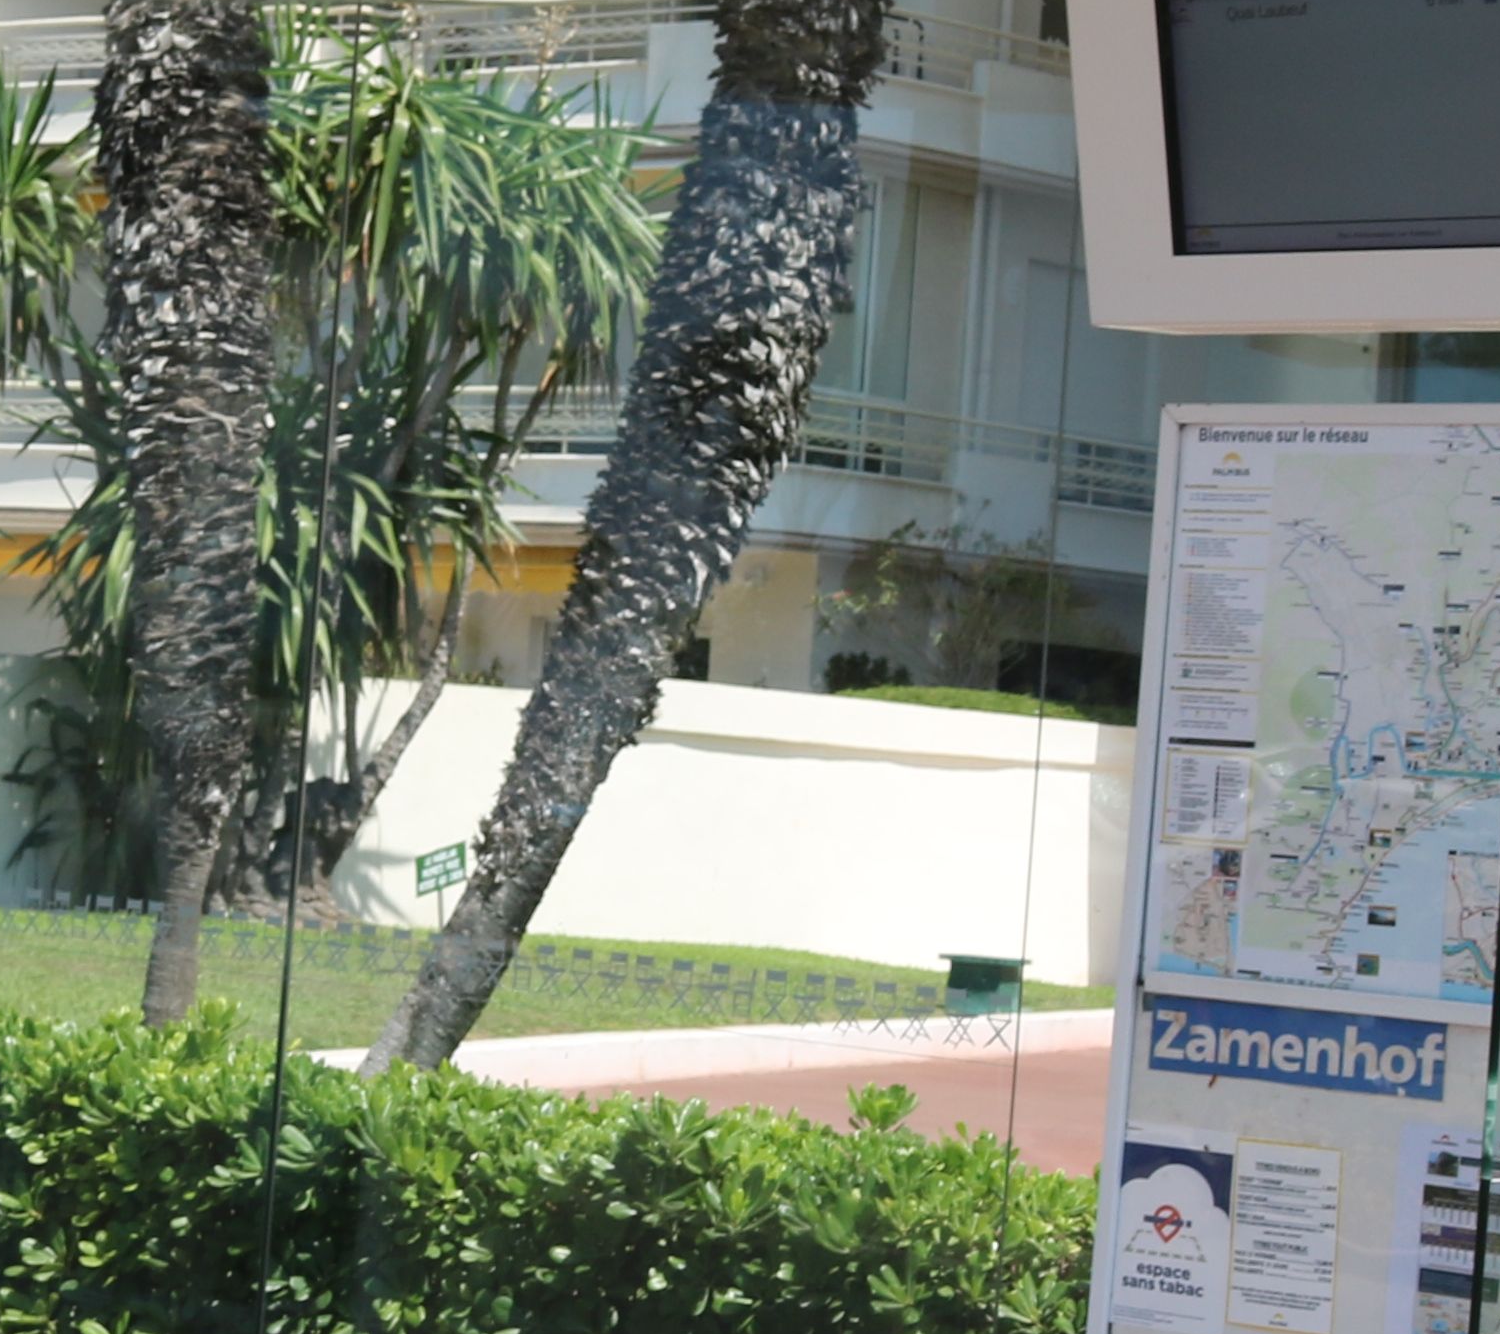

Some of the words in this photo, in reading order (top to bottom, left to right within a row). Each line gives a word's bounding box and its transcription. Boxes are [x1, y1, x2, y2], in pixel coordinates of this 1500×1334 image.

[1198, 427, 1273, 444] Bienvenue
[1277, 430, 1299, 444] sur
[1302, 427, 1316, 444] le
[1319, 427, 1369, 444] réseau
[1153, 1009, 1446, 1087] Zamenhof
[1136, 1262, 1191, 1281] espace
[1122, 1275, 1155, 1291] sans
[1160, 1280, 1205, 1298] tabac
